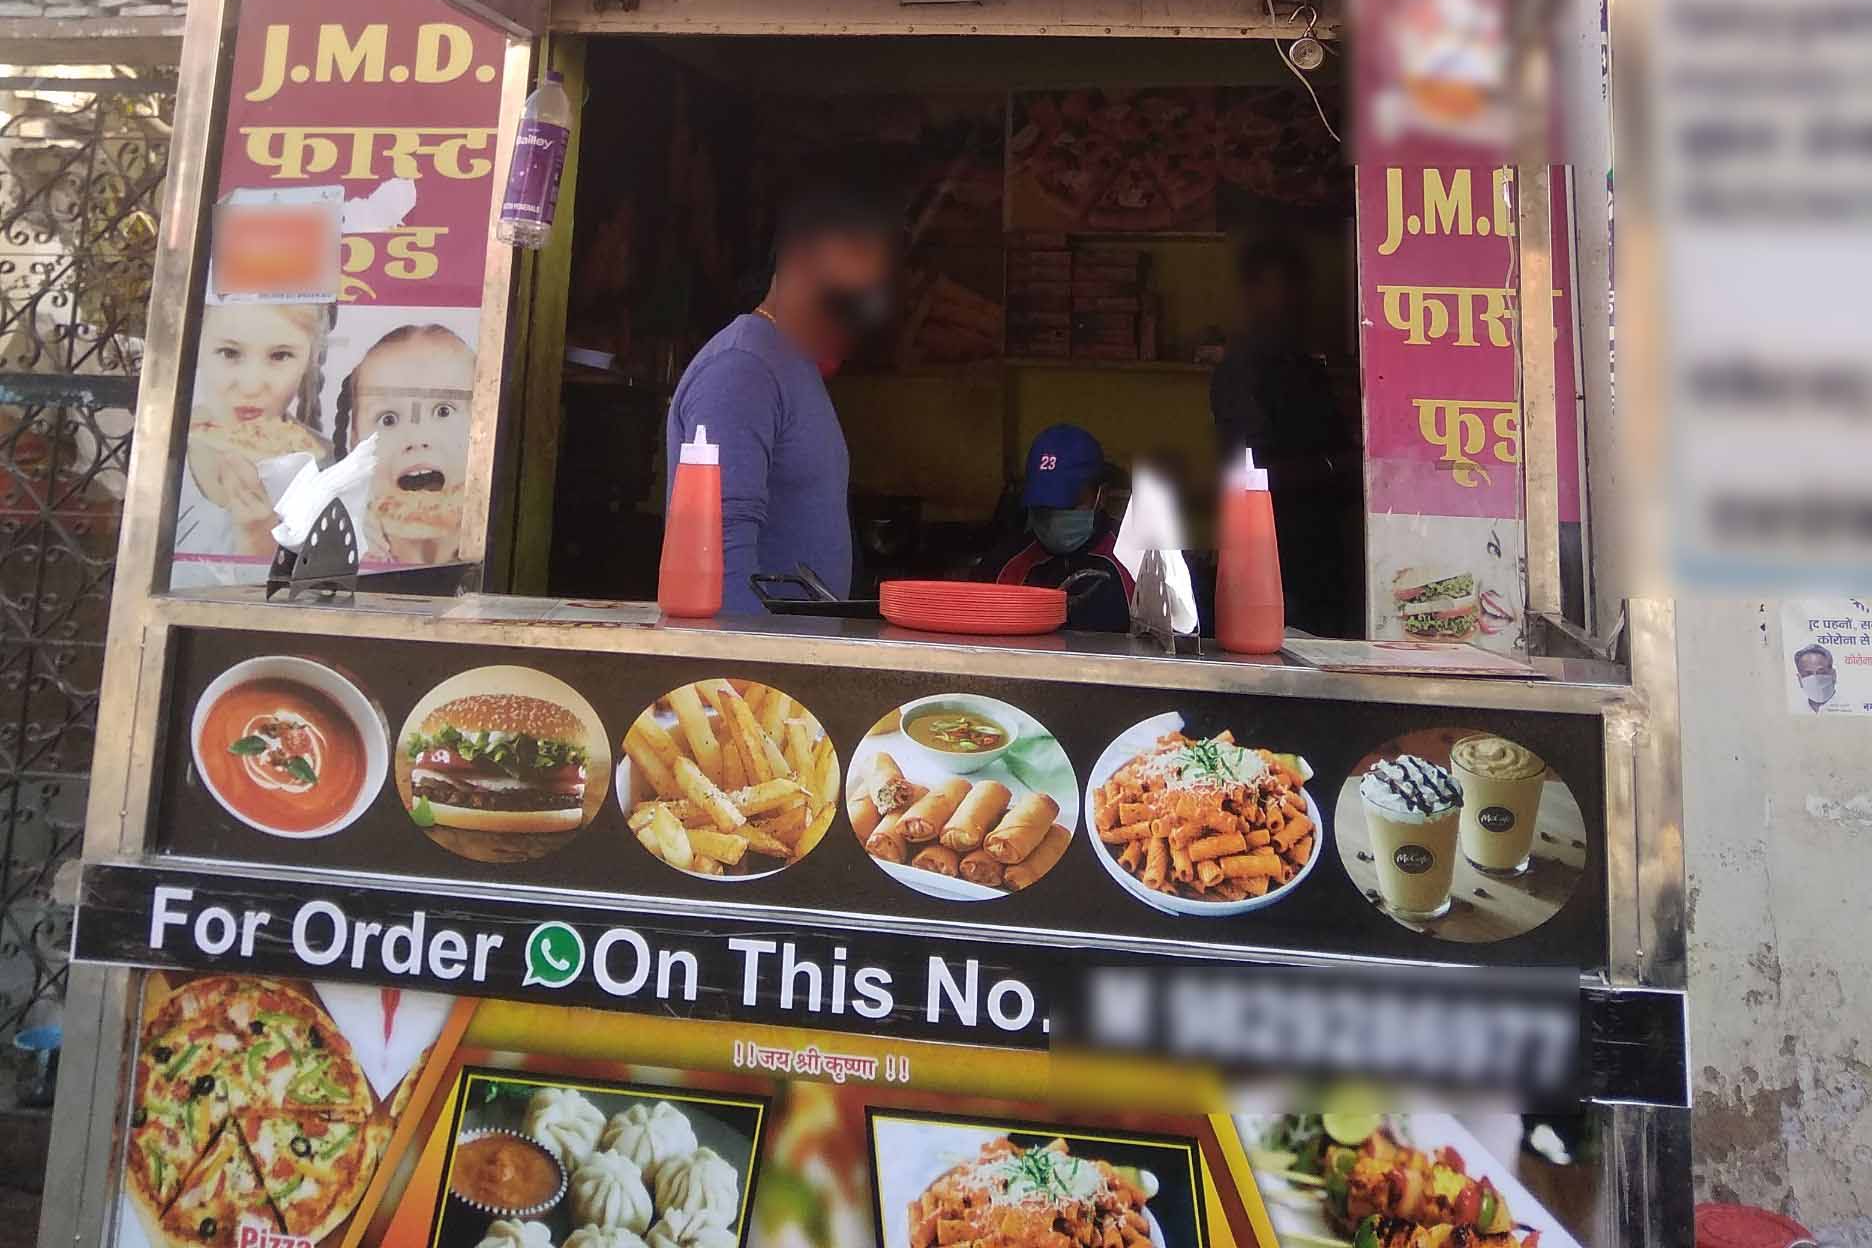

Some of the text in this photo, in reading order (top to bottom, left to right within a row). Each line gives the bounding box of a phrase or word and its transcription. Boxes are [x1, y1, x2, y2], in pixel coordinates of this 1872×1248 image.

[245, 23, 496, 102] J.M.D.
[239, 127, 498, 180] फास्ट
[1040, 455, 1057, 470] 23
[149, 885, 270, 958] For
[292, 899, 504, 984] Order
[592, 927, 699, 1002] On
[728, 937, 895, 1020] This
[926, 955, 1050, 1034] No.
